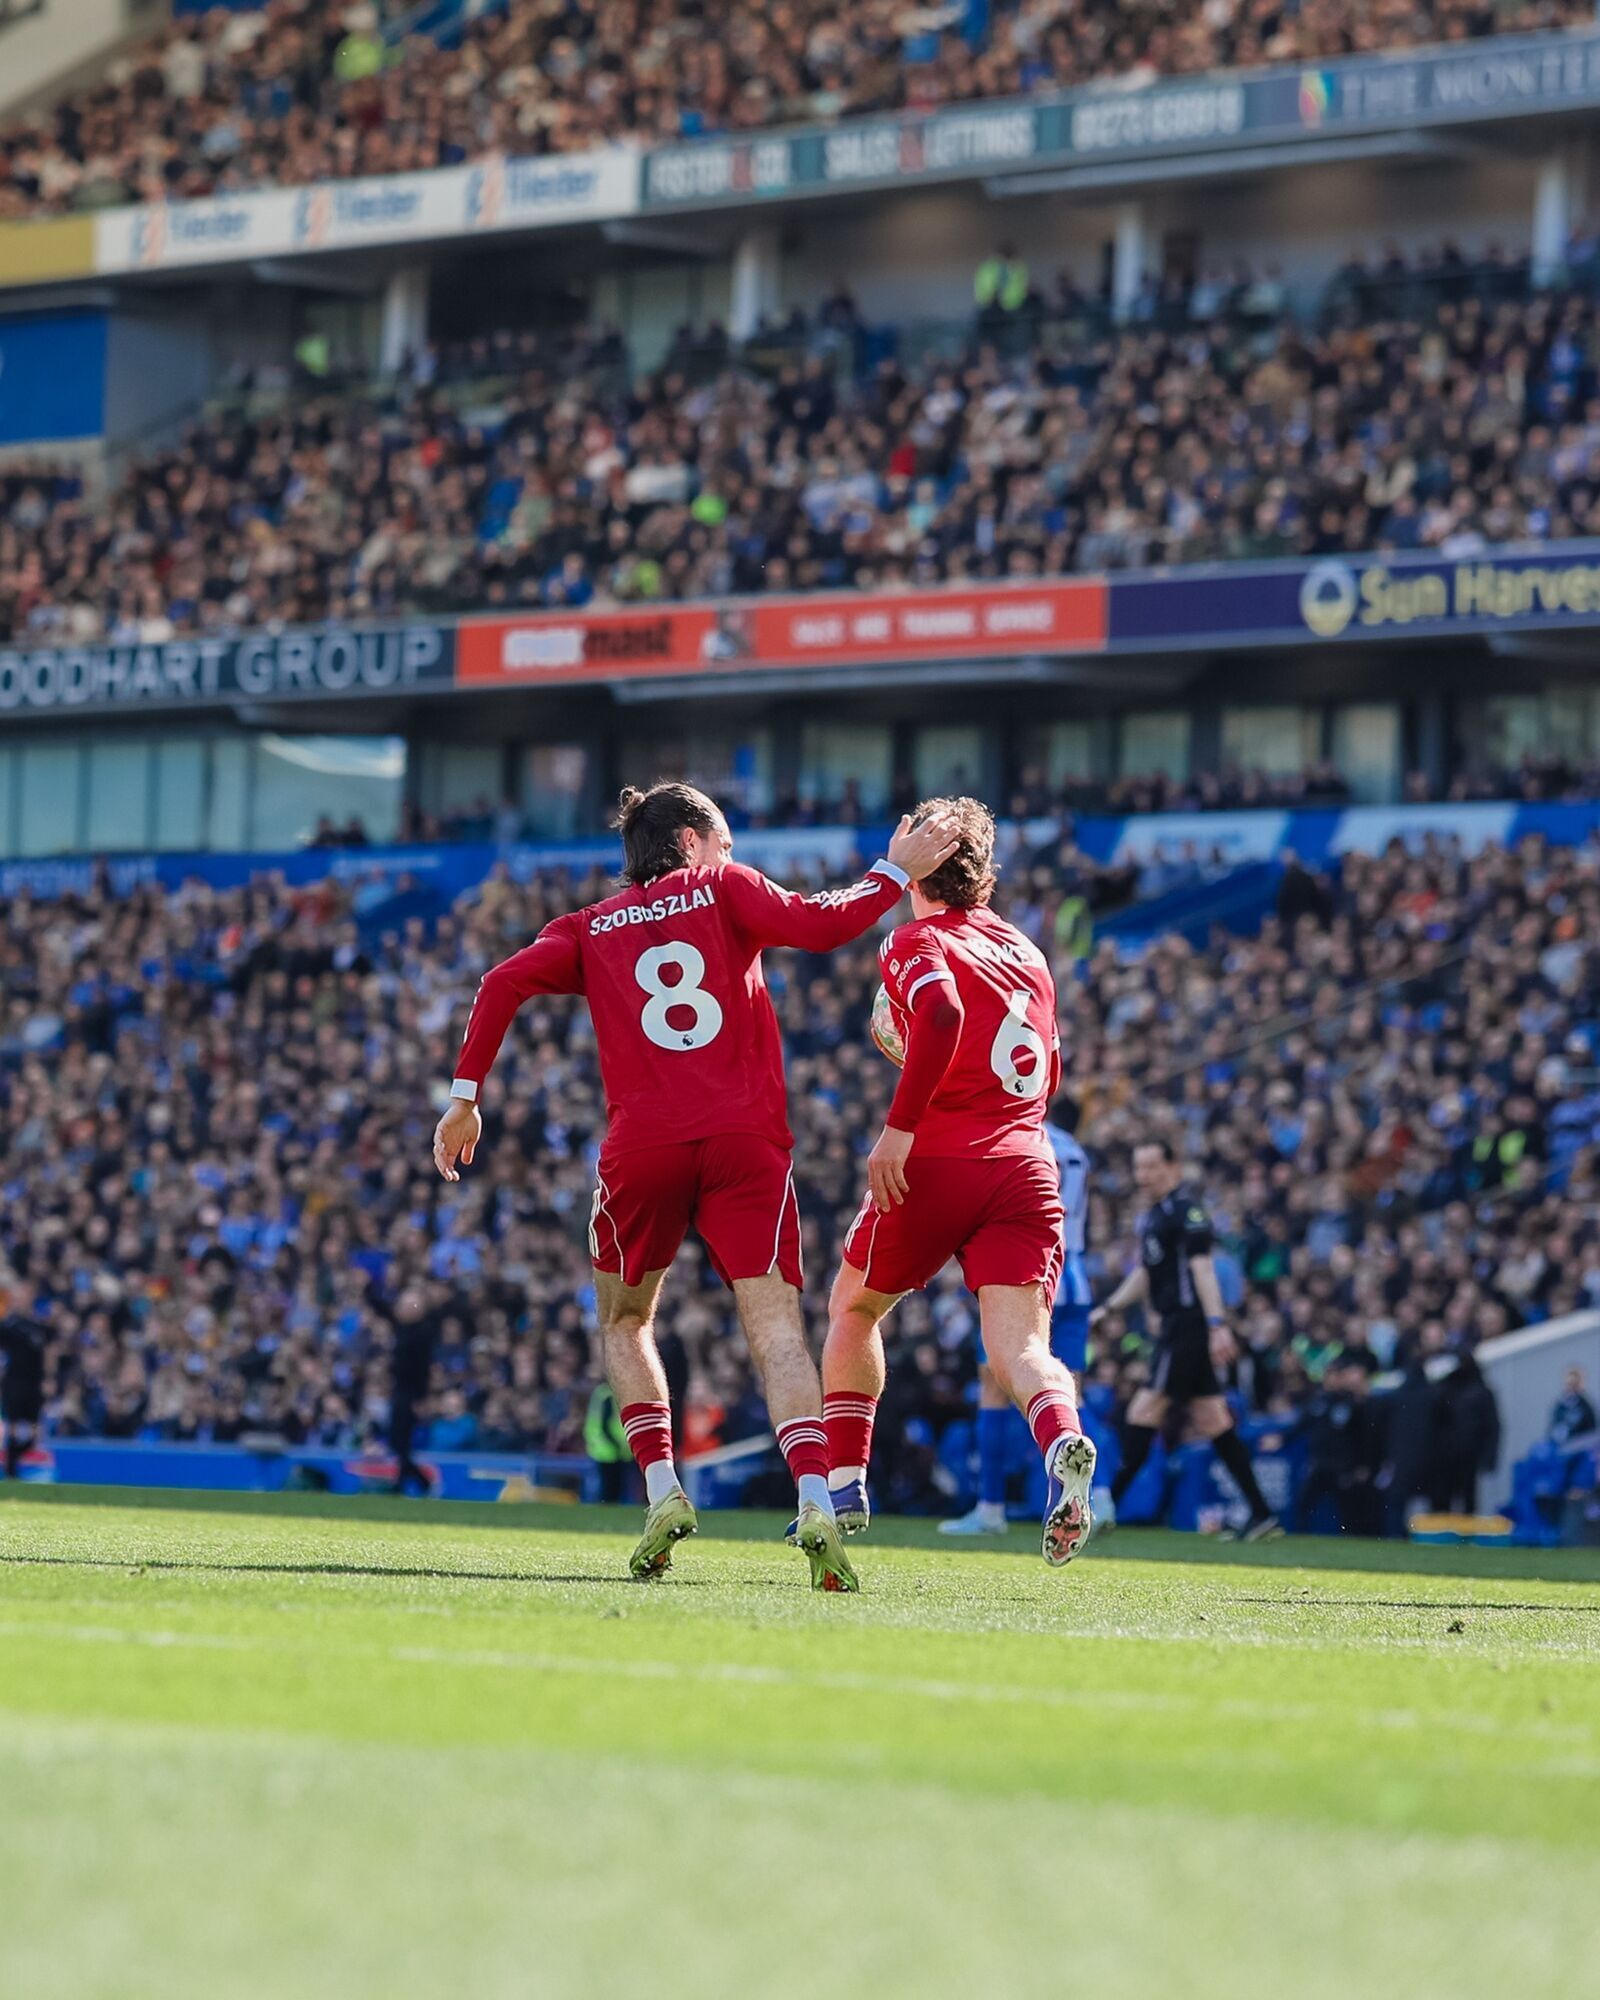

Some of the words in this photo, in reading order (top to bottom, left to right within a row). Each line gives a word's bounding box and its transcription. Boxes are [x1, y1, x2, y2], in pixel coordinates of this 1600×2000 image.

[1360, 565, 1447, 626] Sun
[234, 624, 442, 695] GROUP
[634, 940, 724, 1052] 8
[990, 988, 1047, 1099] 6
